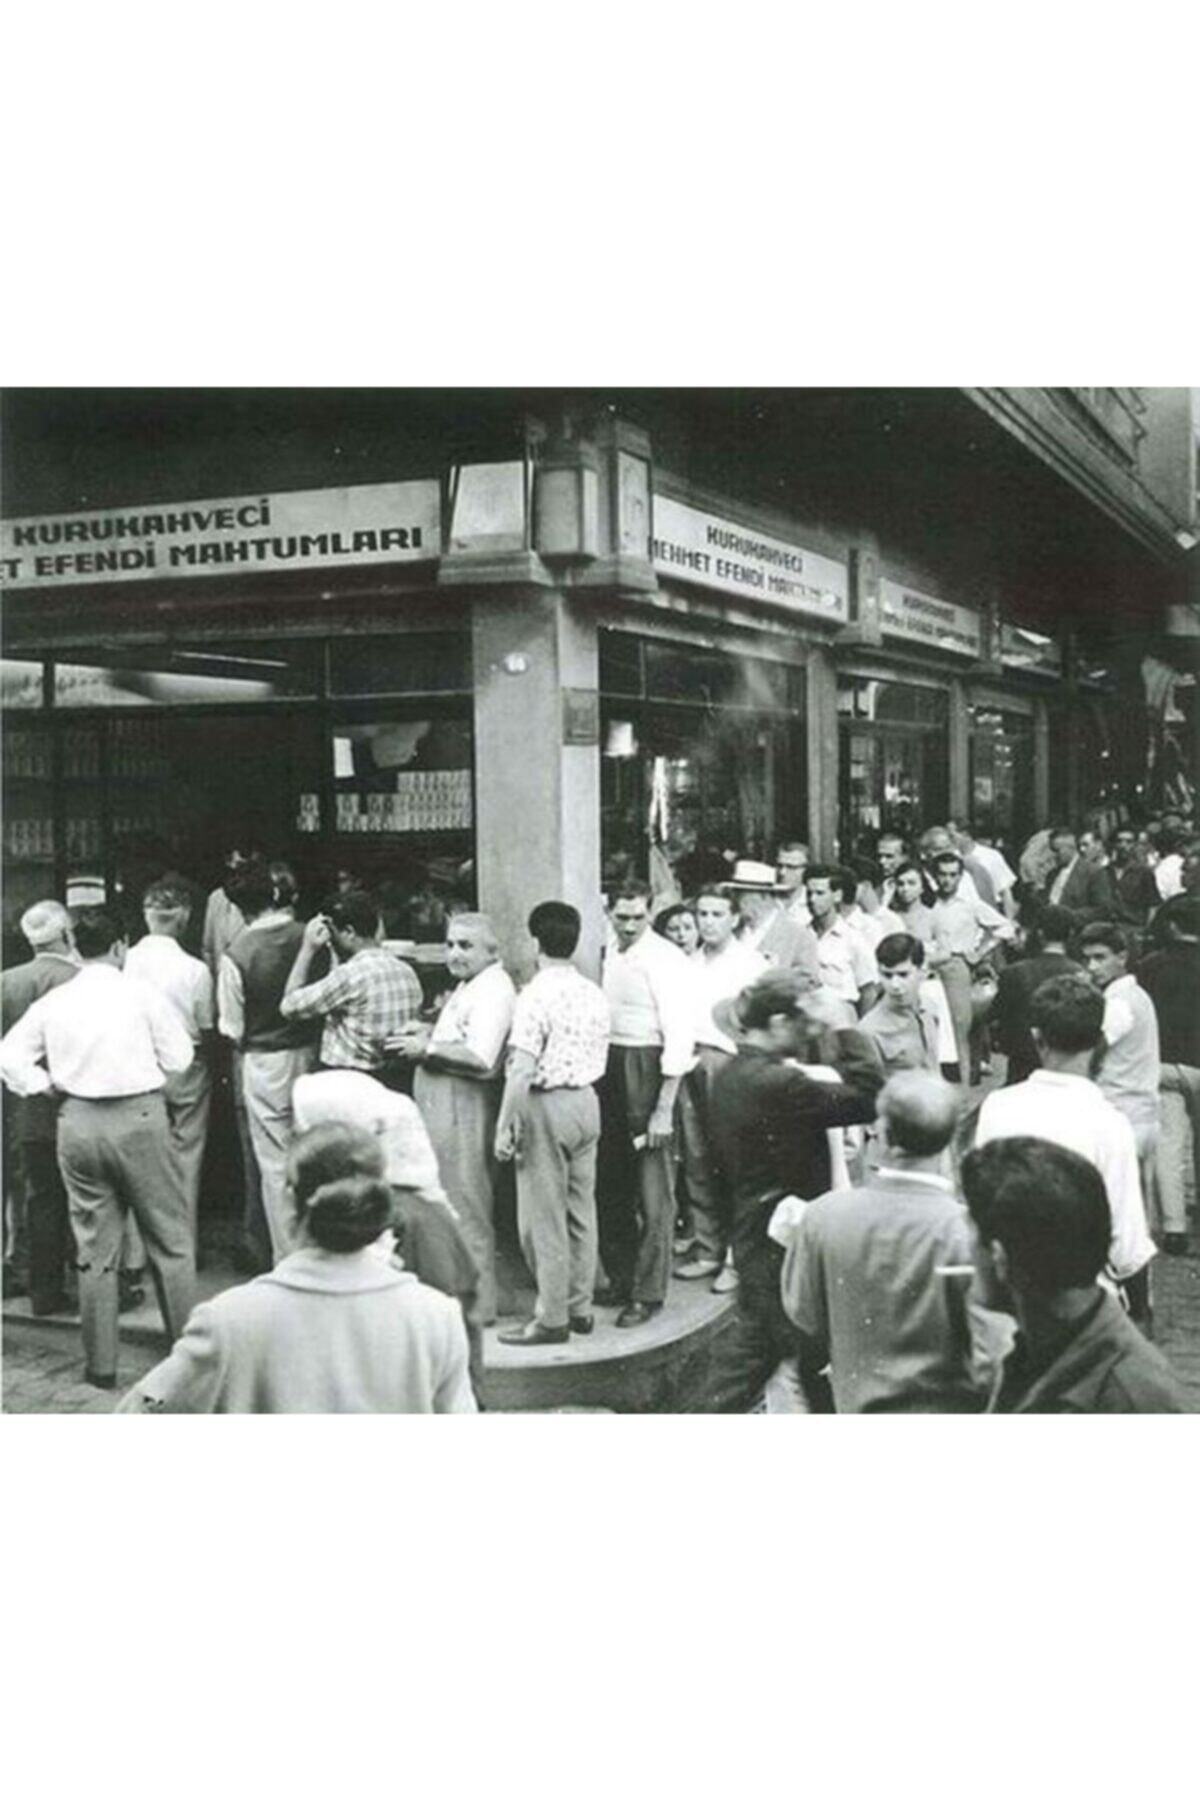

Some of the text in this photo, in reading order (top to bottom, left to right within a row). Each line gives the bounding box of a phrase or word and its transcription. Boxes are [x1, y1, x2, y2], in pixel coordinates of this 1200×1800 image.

[13, 498, 270, 547] KURUKAHVECİ
[35, 541, 156, 577] EFENDİ
[169, 527, 422, 566] MAHTUMLARI
[716, 558, 765, 590] EFENDİ
